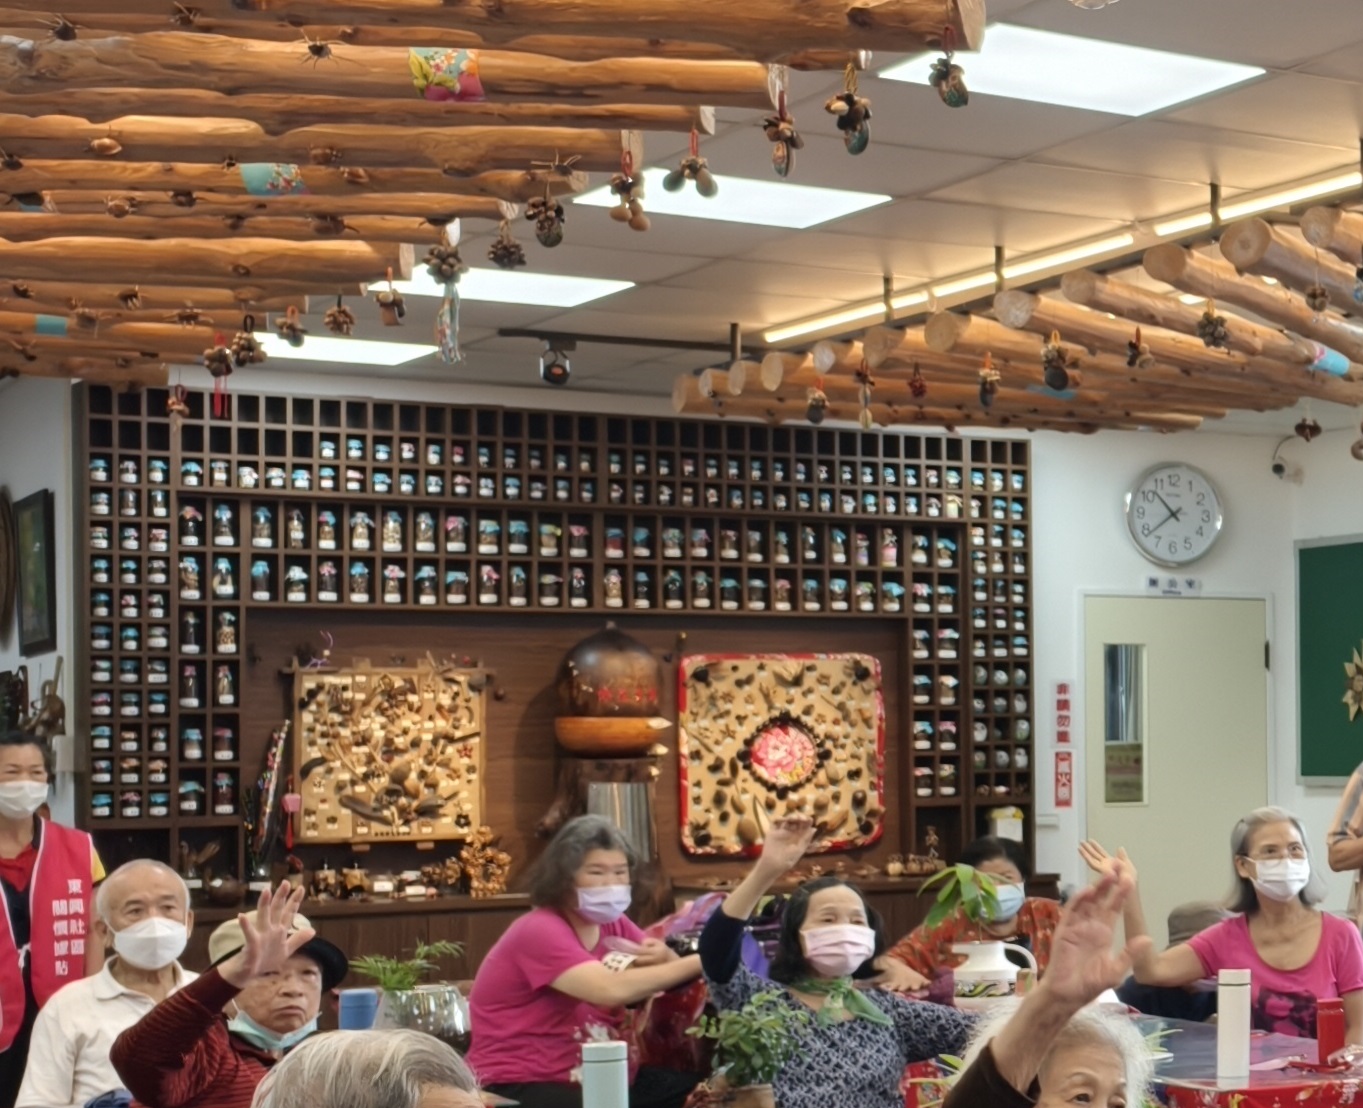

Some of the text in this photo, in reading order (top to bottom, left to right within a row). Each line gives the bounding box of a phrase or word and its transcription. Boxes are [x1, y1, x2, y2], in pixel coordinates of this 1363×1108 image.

[1154, 478, 1165, 491] 11
[1167, 473, 1181, 488] 12
[1187, 480, 1194, 493] 1
[1141, 489, 1156, 504] 10
[1195, 492, 1206, 506] 2
[1136, 505, 1146, 520] 9
[1200, 509, 1211, 523] 3
[1141, 523, 1151, 538] 8
[1195, 525, 1204, 537] 4
[1154, 535, 1162, 548] 7
[1168, 541, 1178, 555] 6
[1183, 536, 1192, 551] 5
